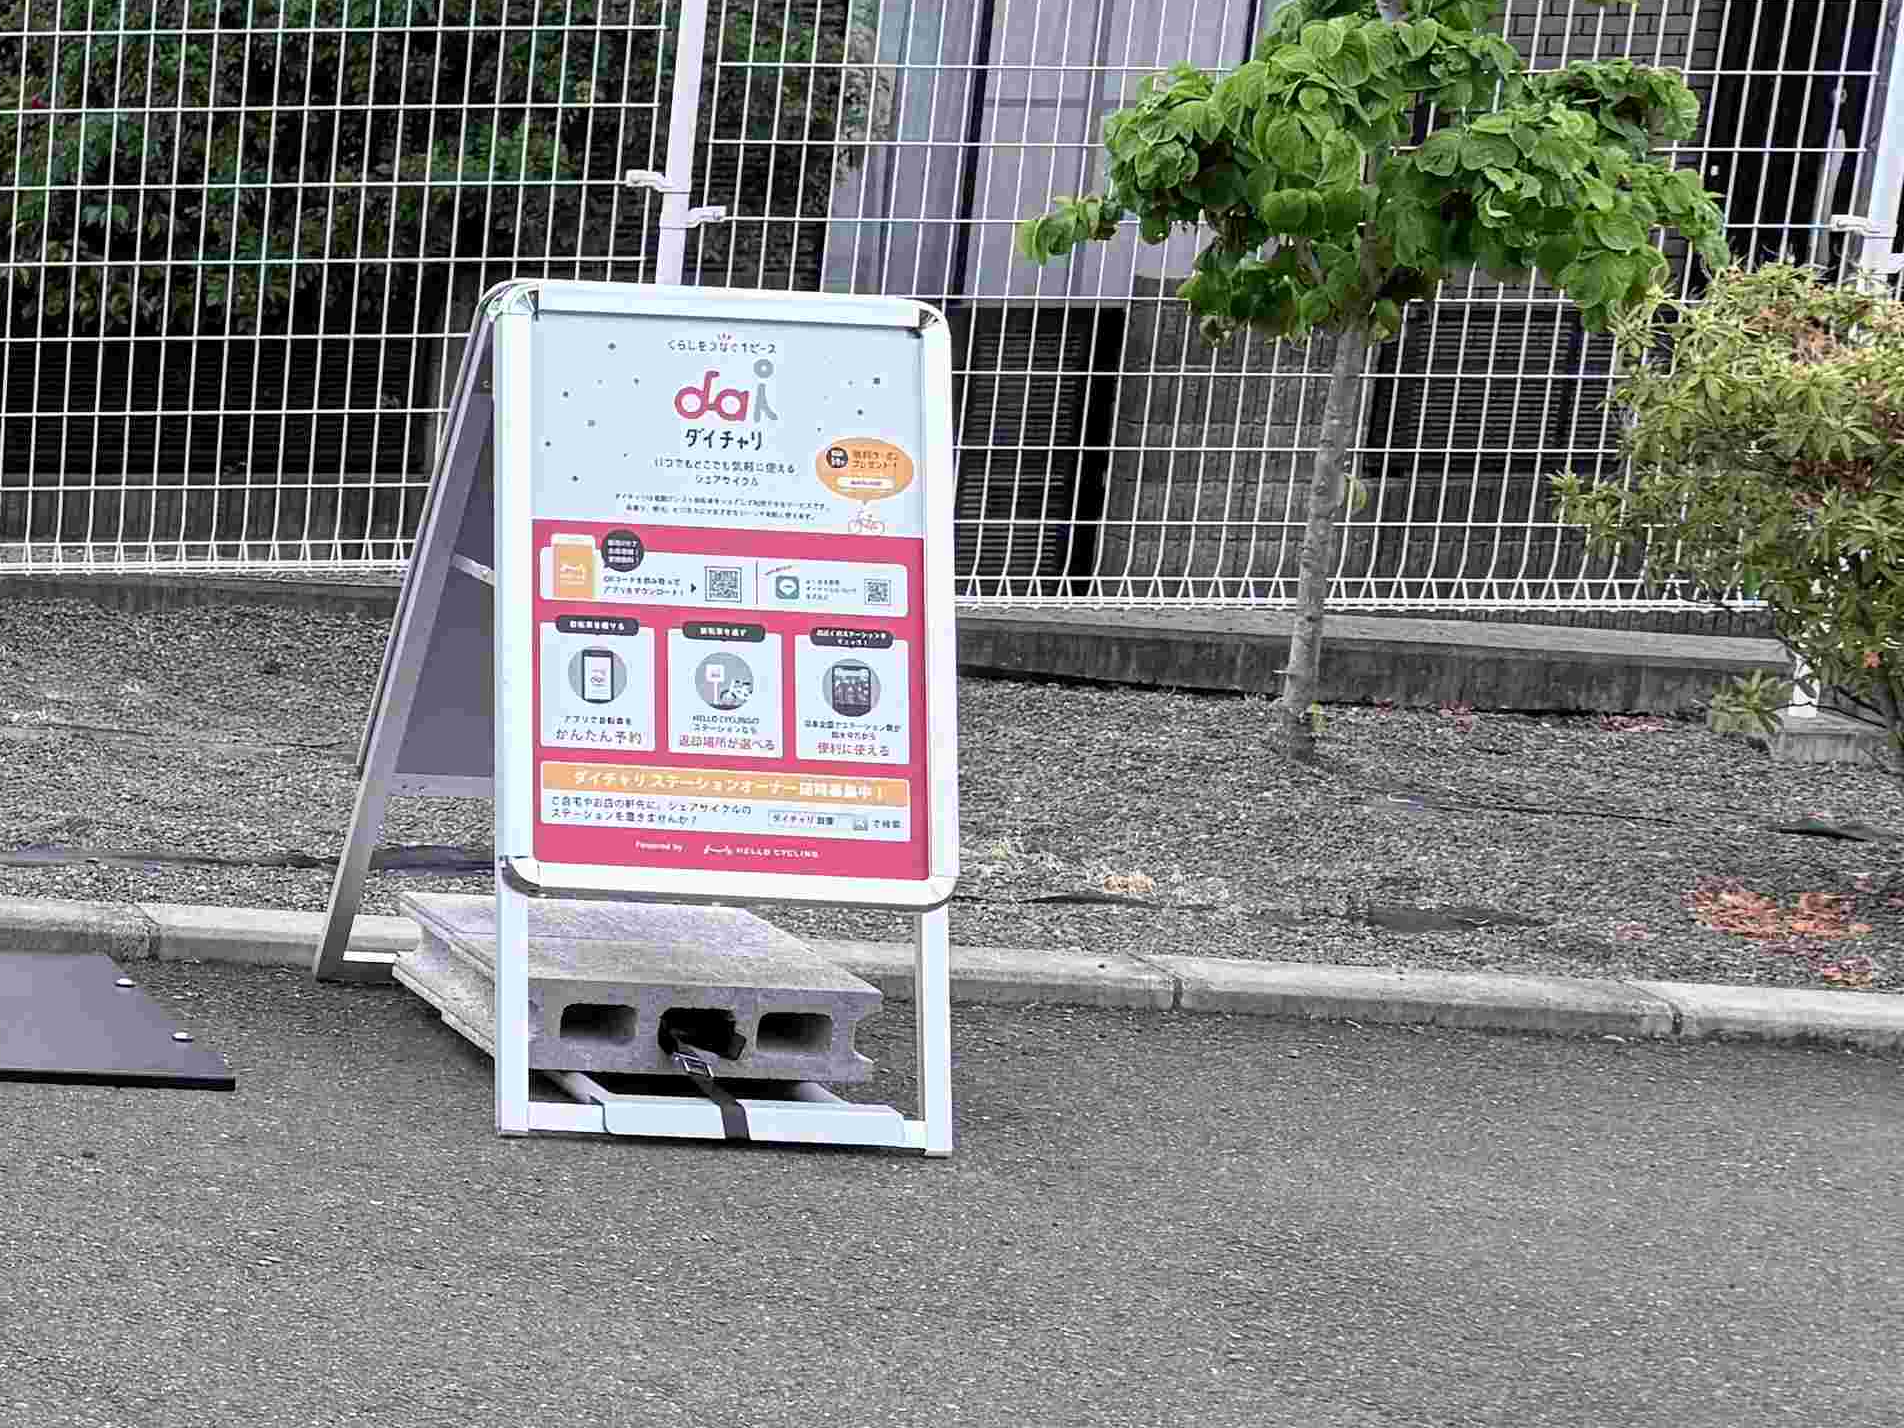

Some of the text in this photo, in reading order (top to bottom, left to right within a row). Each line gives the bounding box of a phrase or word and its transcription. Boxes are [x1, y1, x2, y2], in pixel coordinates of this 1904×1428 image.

[685, 428, 763, 451] ダイチャリ
[555, 728, 642, 746] かんたん予約
